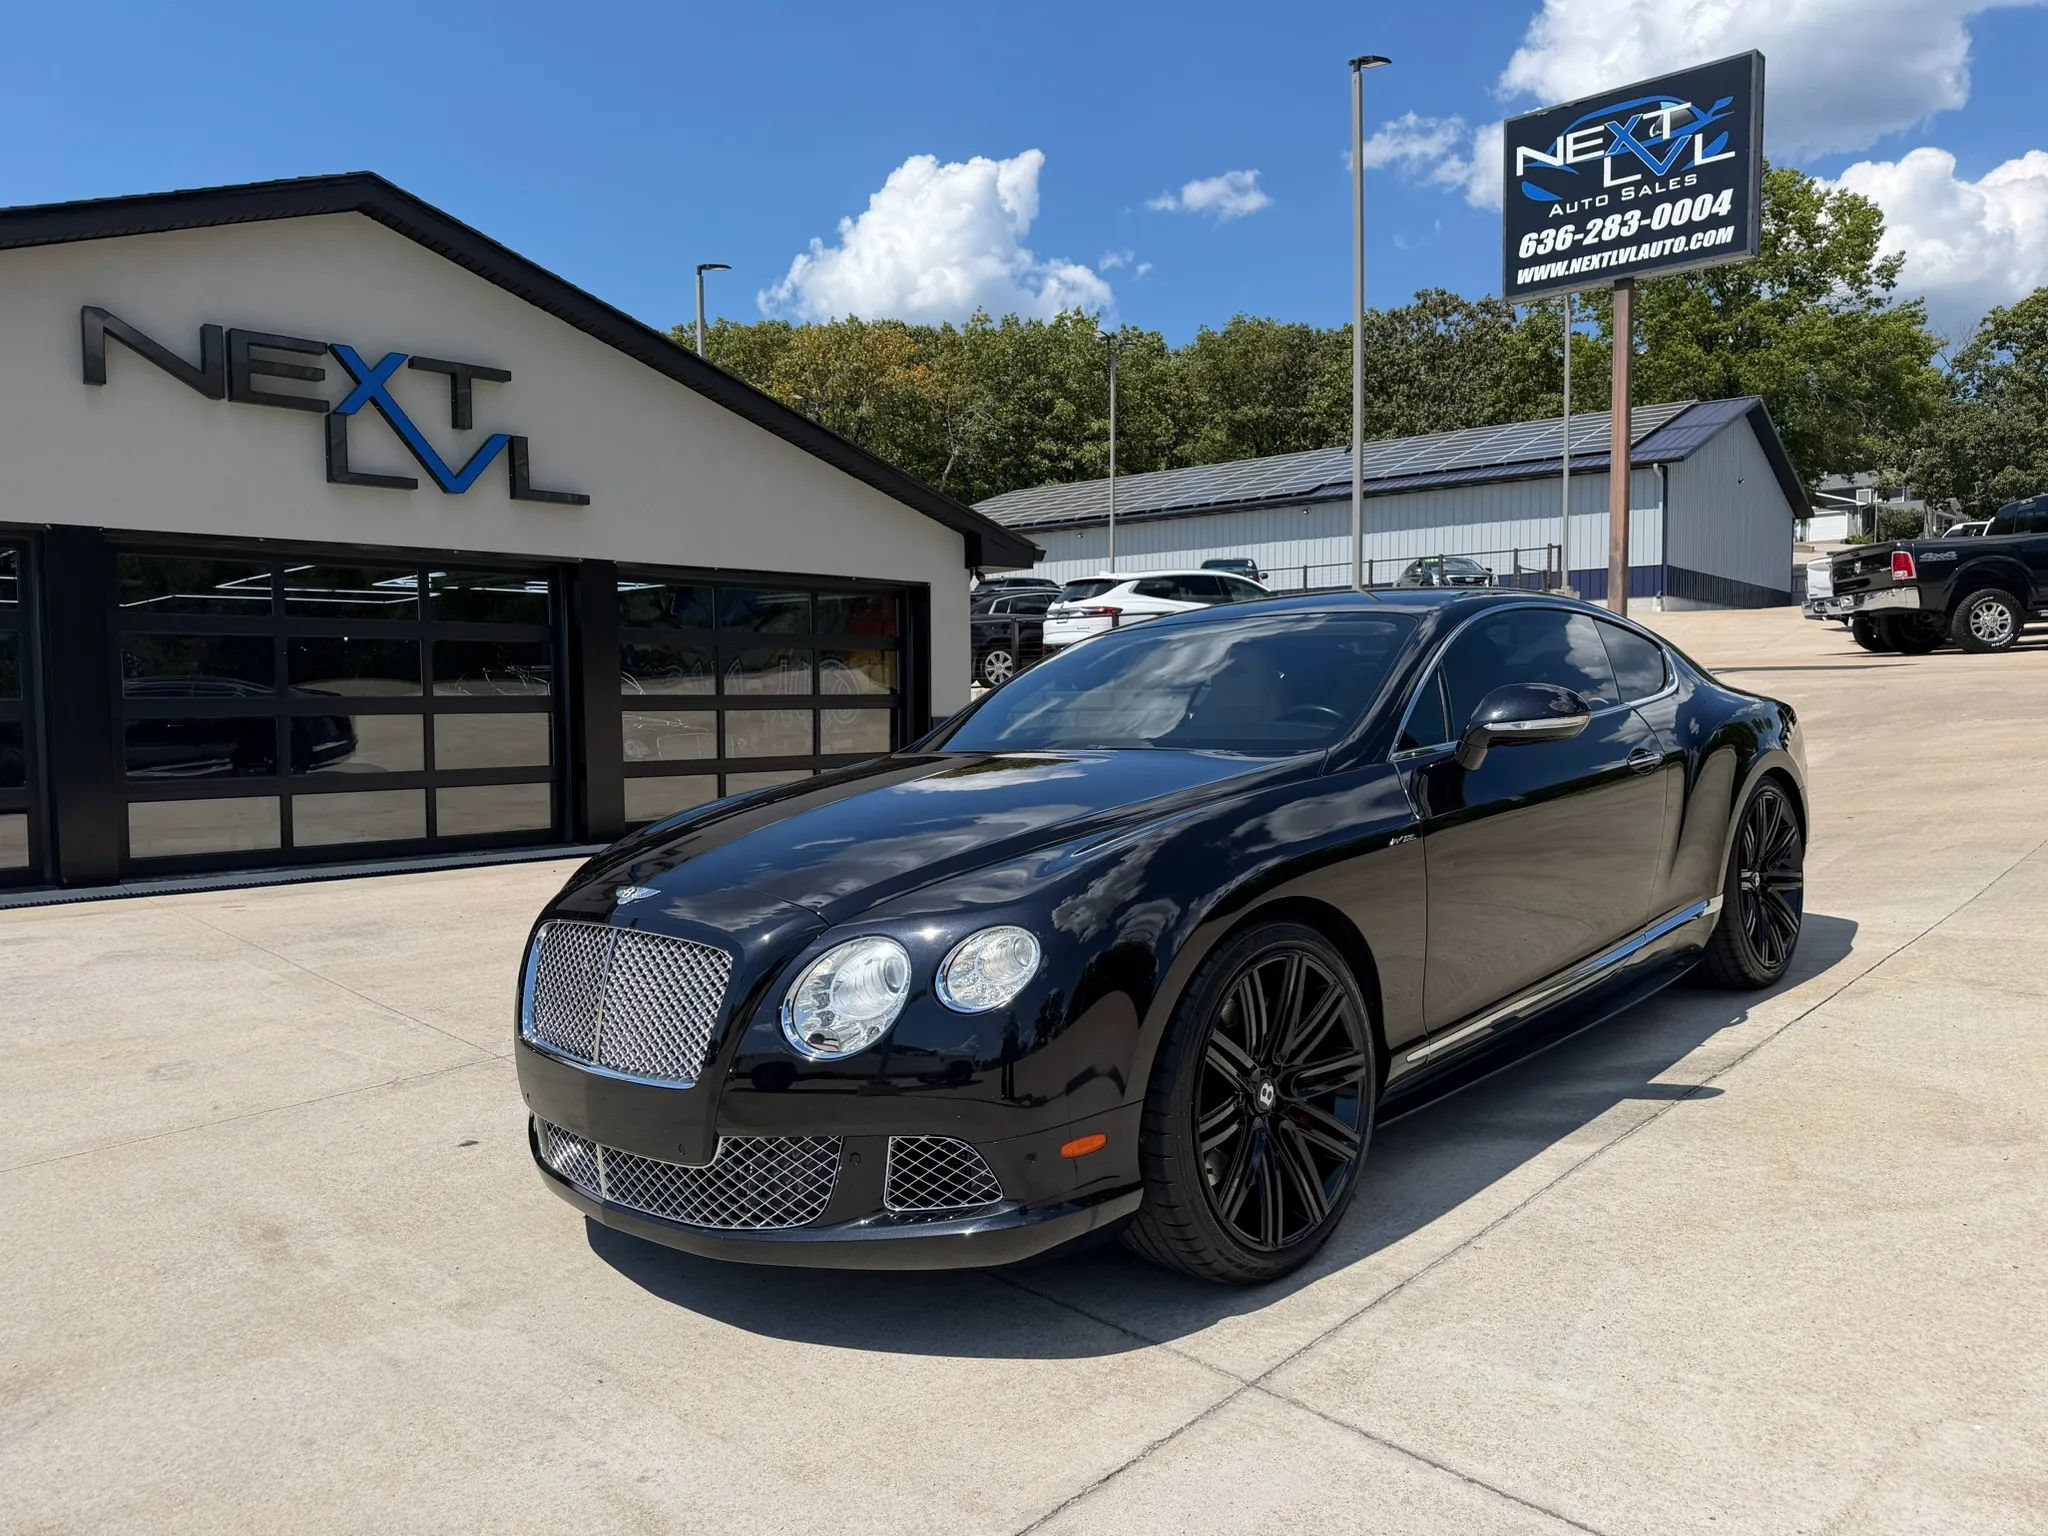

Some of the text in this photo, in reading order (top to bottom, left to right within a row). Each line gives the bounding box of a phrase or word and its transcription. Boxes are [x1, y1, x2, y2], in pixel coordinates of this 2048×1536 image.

[1516, 102, 1691, 176] NEXT
[1604, 134, 1735, 188] LVL
[1517, 226, 1735, 284] WWW.NEXTLVLAUTO.COM
[1518, 188, 1734, 258] 636-283-0004
[81, 305, 512, 430] NEXT
[324, 412, 590, 505] LVL
